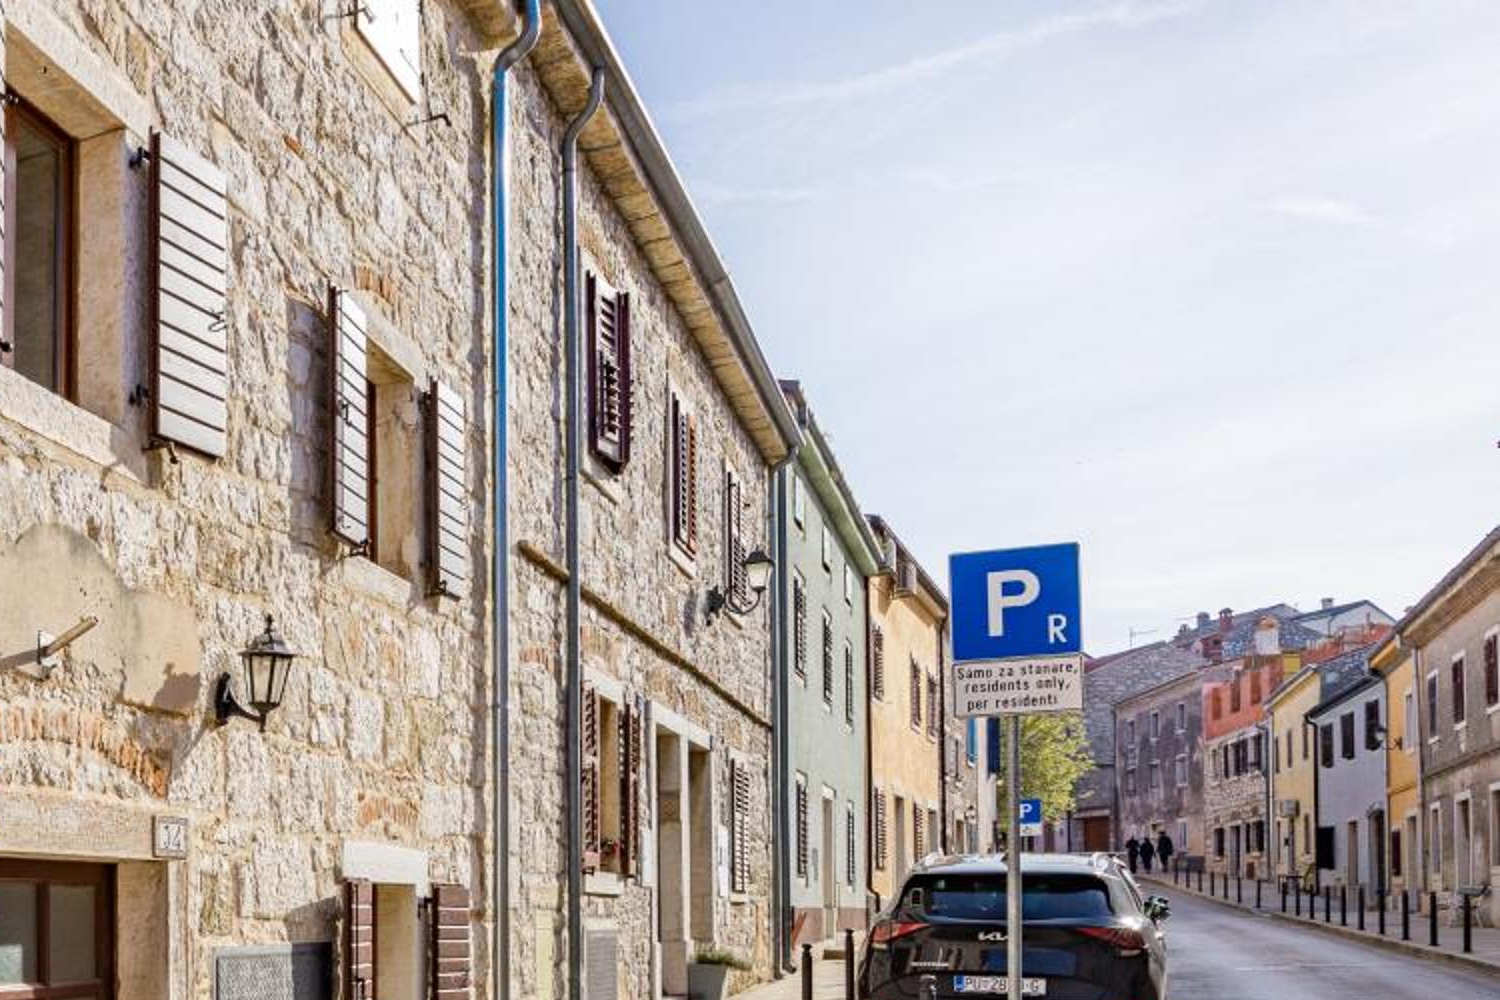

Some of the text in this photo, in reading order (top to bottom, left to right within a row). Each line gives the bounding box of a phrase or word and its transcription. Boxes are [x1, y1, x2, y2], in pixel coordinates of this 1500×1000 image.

[987, 569, 1040, 637] P
[1047, 613, 1068, 644] R
[957, 662, 1078, 680] Samo za stanare,
[965, 676, 1071, 693] residents only,
[967, 693, 1058, 712] per residenti
[1019, 803, 1033, 819] P
